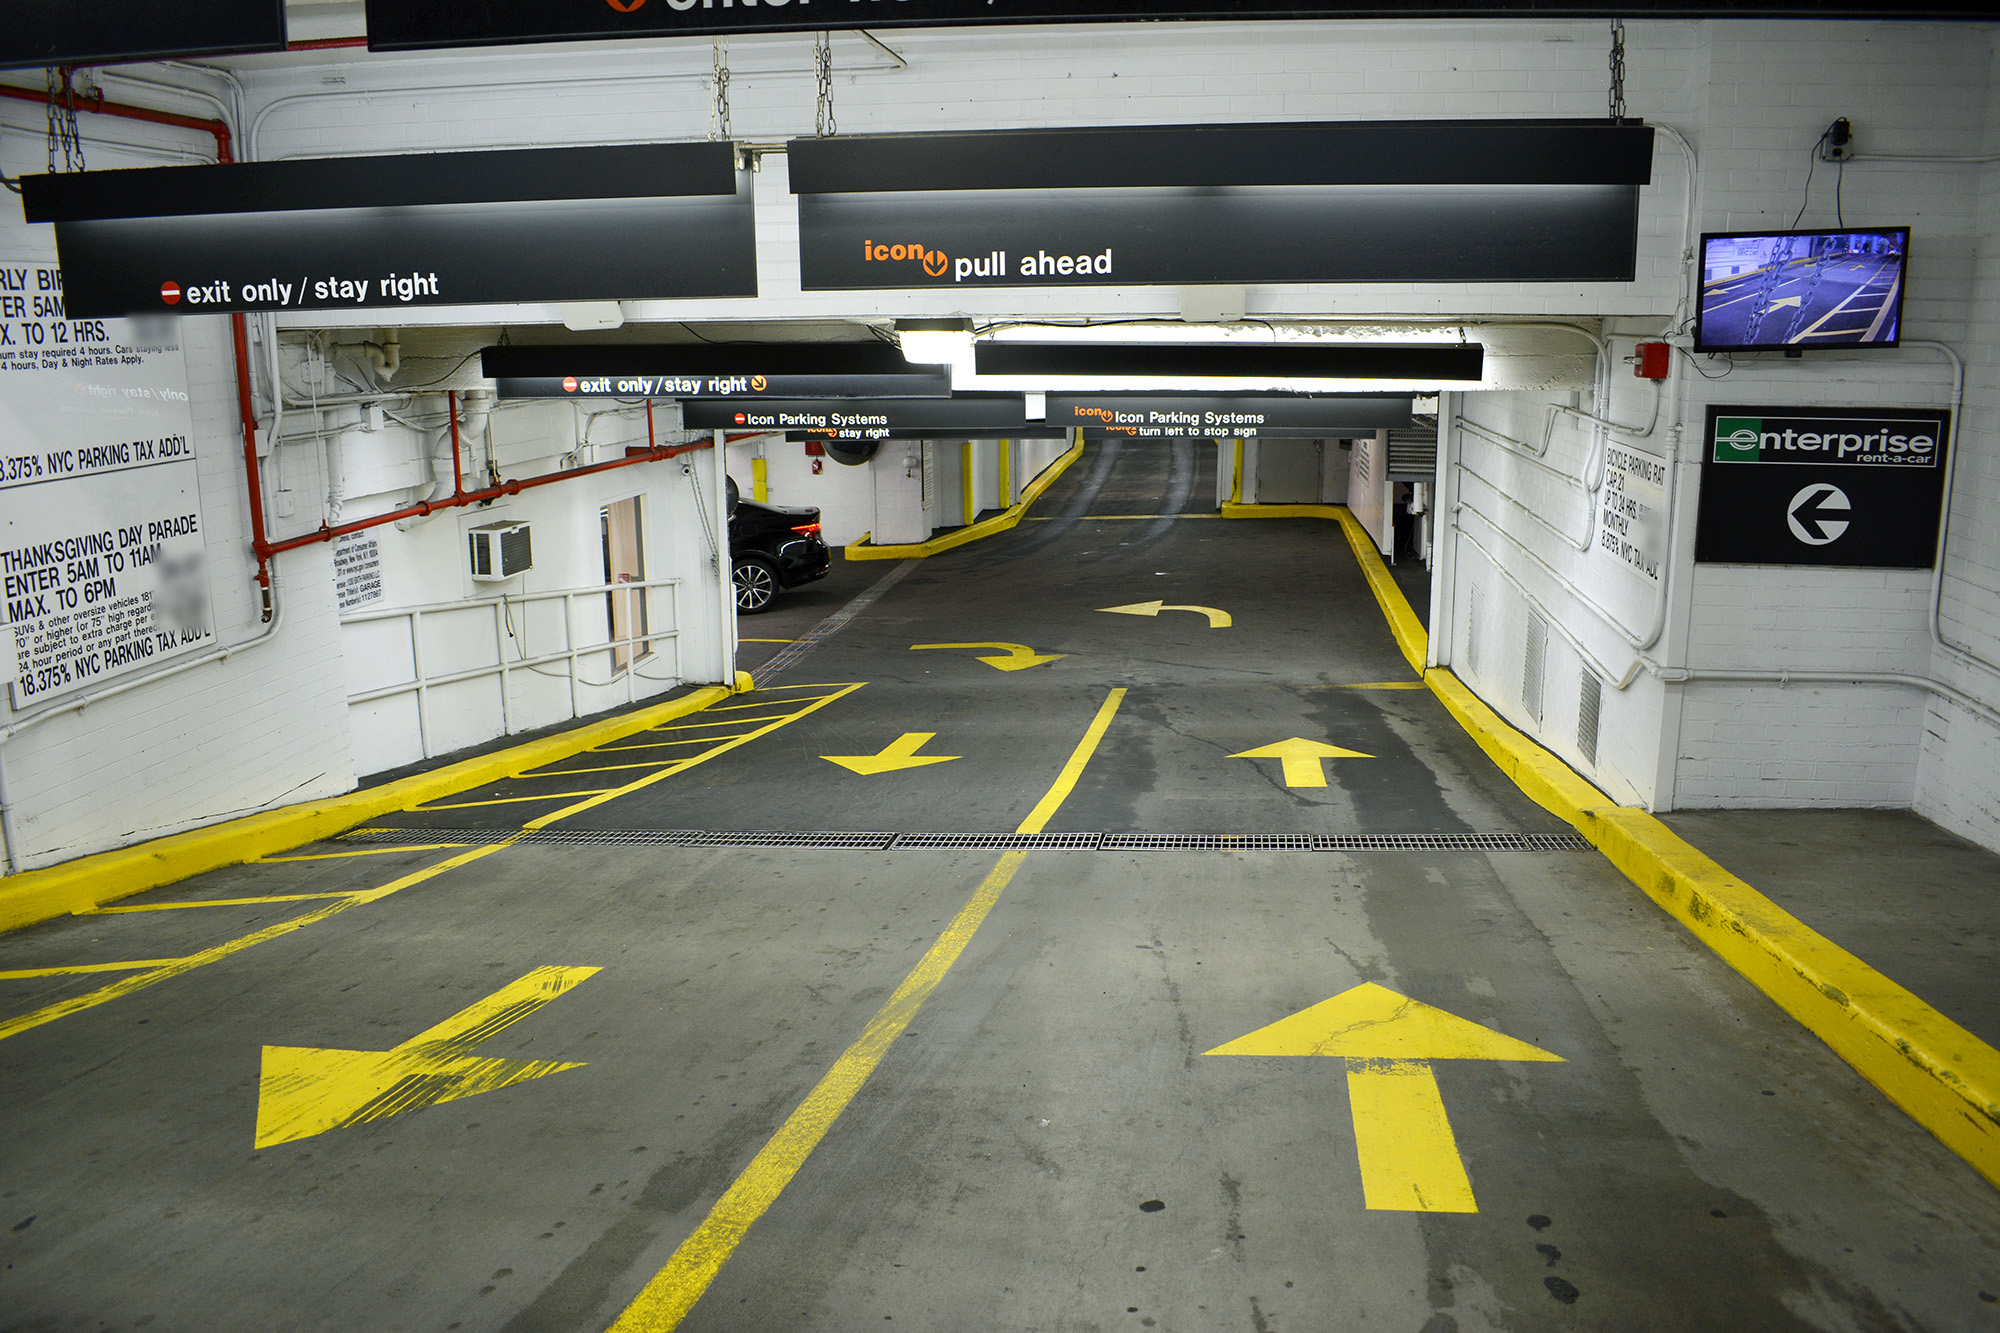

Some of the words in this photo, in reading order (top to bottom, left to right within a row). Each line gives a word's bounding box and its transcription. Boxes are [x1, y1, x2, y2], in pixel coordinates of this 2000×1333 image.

[865, 240, 924, 260] icon
[955, 251, 1006, 282] pull
[1020, 248, 1112, 276] ahead
[186, 280, 231, 304] exit
[242, 278, 292, 306] only
[315, 276, 368, 304] stay
[380, 272, 439, 301] right
[0, 296, 26, 318] ER
[34, 296, 65, 318] 5AM
[21, 322, 44, 344] TO
[51, 321, 68, 343] 12
[73, 320, 109, 343] HRS.
[1, 361, 7, 371] 4
[12, 361, 39, 371] hours,
[42, 359, 60, 370] Day
[62, 359, 68, 368] &
[72, 357, 93, 369] Night
[96, 356, 118, 366] Rates
[120, 354, 144, 365] Apply.
[20, 348, 38, 360] stay
[42, 346, 77, 359] required
[80, 347, 86, 356] 4
[88, 346, 113, 356] hours.
[115, 345, 133, 355] Cars
[136, 344, 162, 354] staying
[580, 377, 611, 392] exit
[707, 376, 747, 395] right
[747, 413, 775, 425] Icon
[779, 413, 826, 427] Parking
[831, 413, 888, 427] Systems
[1074, 406, 1102, 416] icon
[1115, 411, 1144, 423] Icon
[1149, 411, 1200, 425] Parking
[1204, 411, 1265, 425] Systems
[839, 428, 861, 439] stay
[865, 428, 889, 439] right
[1139, 427, 1161, 437] turn
[1164, 426, 1183, 436] left
[1188, 427, 1200, 436] to
[1204, 427, 1229, 438] stop
[1233, 427, 1257, 438] sign
[1729, 428, 1934, 458] enterprise
[47, 450, 74, 474] NYC
[78, 443, 129, 470] PARKING
[133, 440, 155, 461] TAX
[159, 436, 190, 458] ADD'L
[1607, 448, 1627, 471] BICYCLE
[1628, 455, 1652, 481] PARKING
[1857, 452, 1932, 464] rent-a-car
[1603, 508, 1629, 537] MONTHLY
[0, 531, 114, 573] THANKSGIVING
[118, 525, 143, 548] DAY
[148, 514, 198, 541] PARADE
[1620, 540, 1632, 563] NYC
[1634, 548, 1645, 571] TAX
[5, 566, 60, 599] ENTER
[67, 557, 100, 584] 5AM
[104, 552, 124, 573] TO
[360, 579, 381, 593] GARAGE
[8, 594, 51, 623] MAX.
[56, 587, 77, 610] TO
[84, 577, 116, 603] 6PM
[14, 624, 35, 638] SUVs
[39, 620, 45, 631] &
[48, 615, 70, 628] other
[73, 605, 106, 621] oversize
[109, 598, 139, 611] vehicles
[34, 635, 43, 644] or
[46, 627, 73, 642] higher
[77, 622, 88, 634] (or
[108, 611, 125, 623] high
[17, 649, 30, 660] are
[34, 639, 67, 656] subject
[70, 634, 79, 644] to
[82, 629, 103, 641] extra
[106, 619, 133, 634] charge
[135, 616, 148, 628] per
[32, 657, 53, 669] hour
[56, 646, 83, 661] period
[86, 644, 95, 653] or
[97, 638, 113, 650] any
[115, 632, 132, 645] part
[19, 663, 71, 697] 18.375%
[75, 653, 101, 679] NYC
[104, 636, 154, 670] PARKING
[156, 629, 178, 653] TAX
